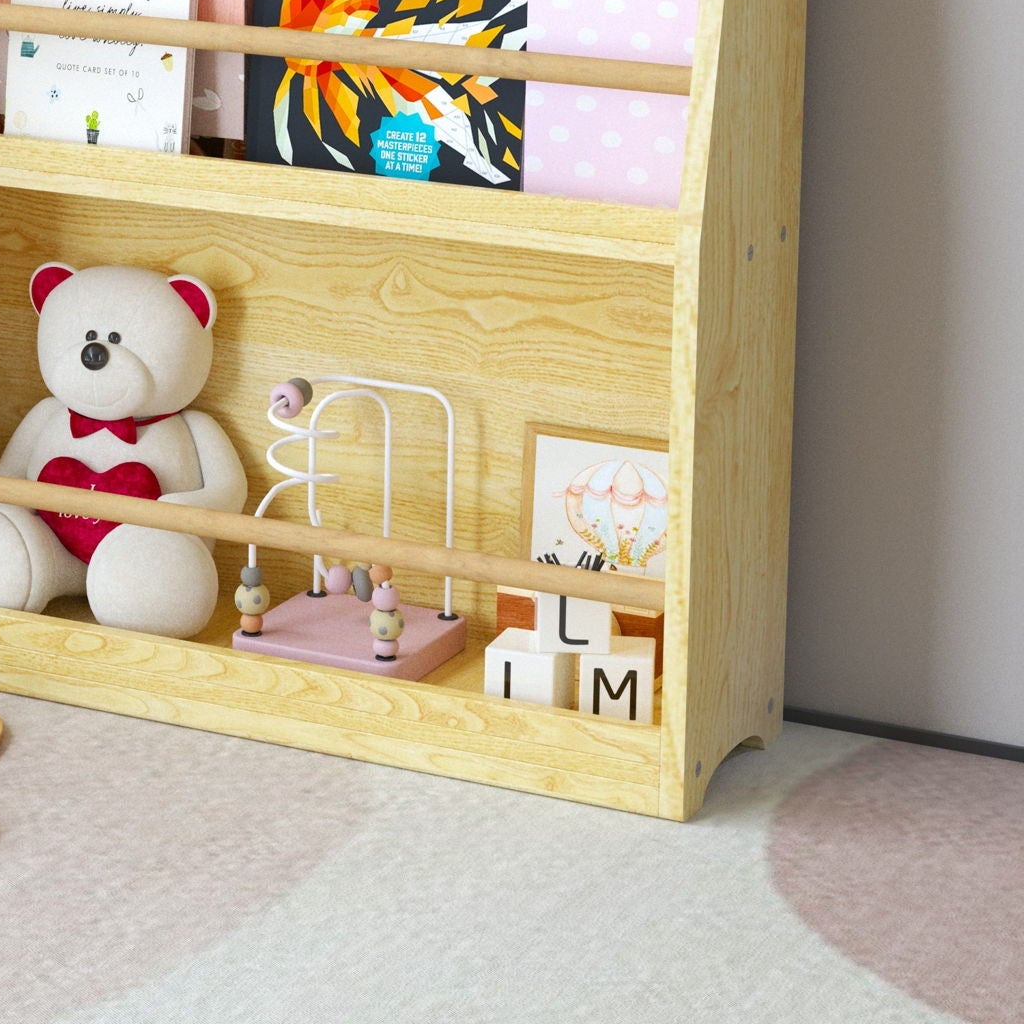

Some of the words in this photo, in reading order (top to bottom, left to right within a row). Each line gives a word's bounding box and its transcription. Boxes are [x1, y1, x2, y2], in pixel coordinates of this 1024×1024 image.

[56, 62, 80, 72] QUOTE
[82, 65, 102, 75] CARD
[104, 68, 116, 76] SET
[118, 69, 128, 77] OF
[131, 70, 140, 78] 10
[386, 130, 414, 142] CREATE
[416, 132, 427, 143] 12
[377, 139, 433, 154] MASTERPIECES
[380, 150, 396, 160] ONE
[397, 152, 428, 164] STICKER
[385, 161, 394, 170] AT
[395, 162, 401, 171] A
[401, 163, 423, 173] TIME!
[593, 666, 638, 721] M
